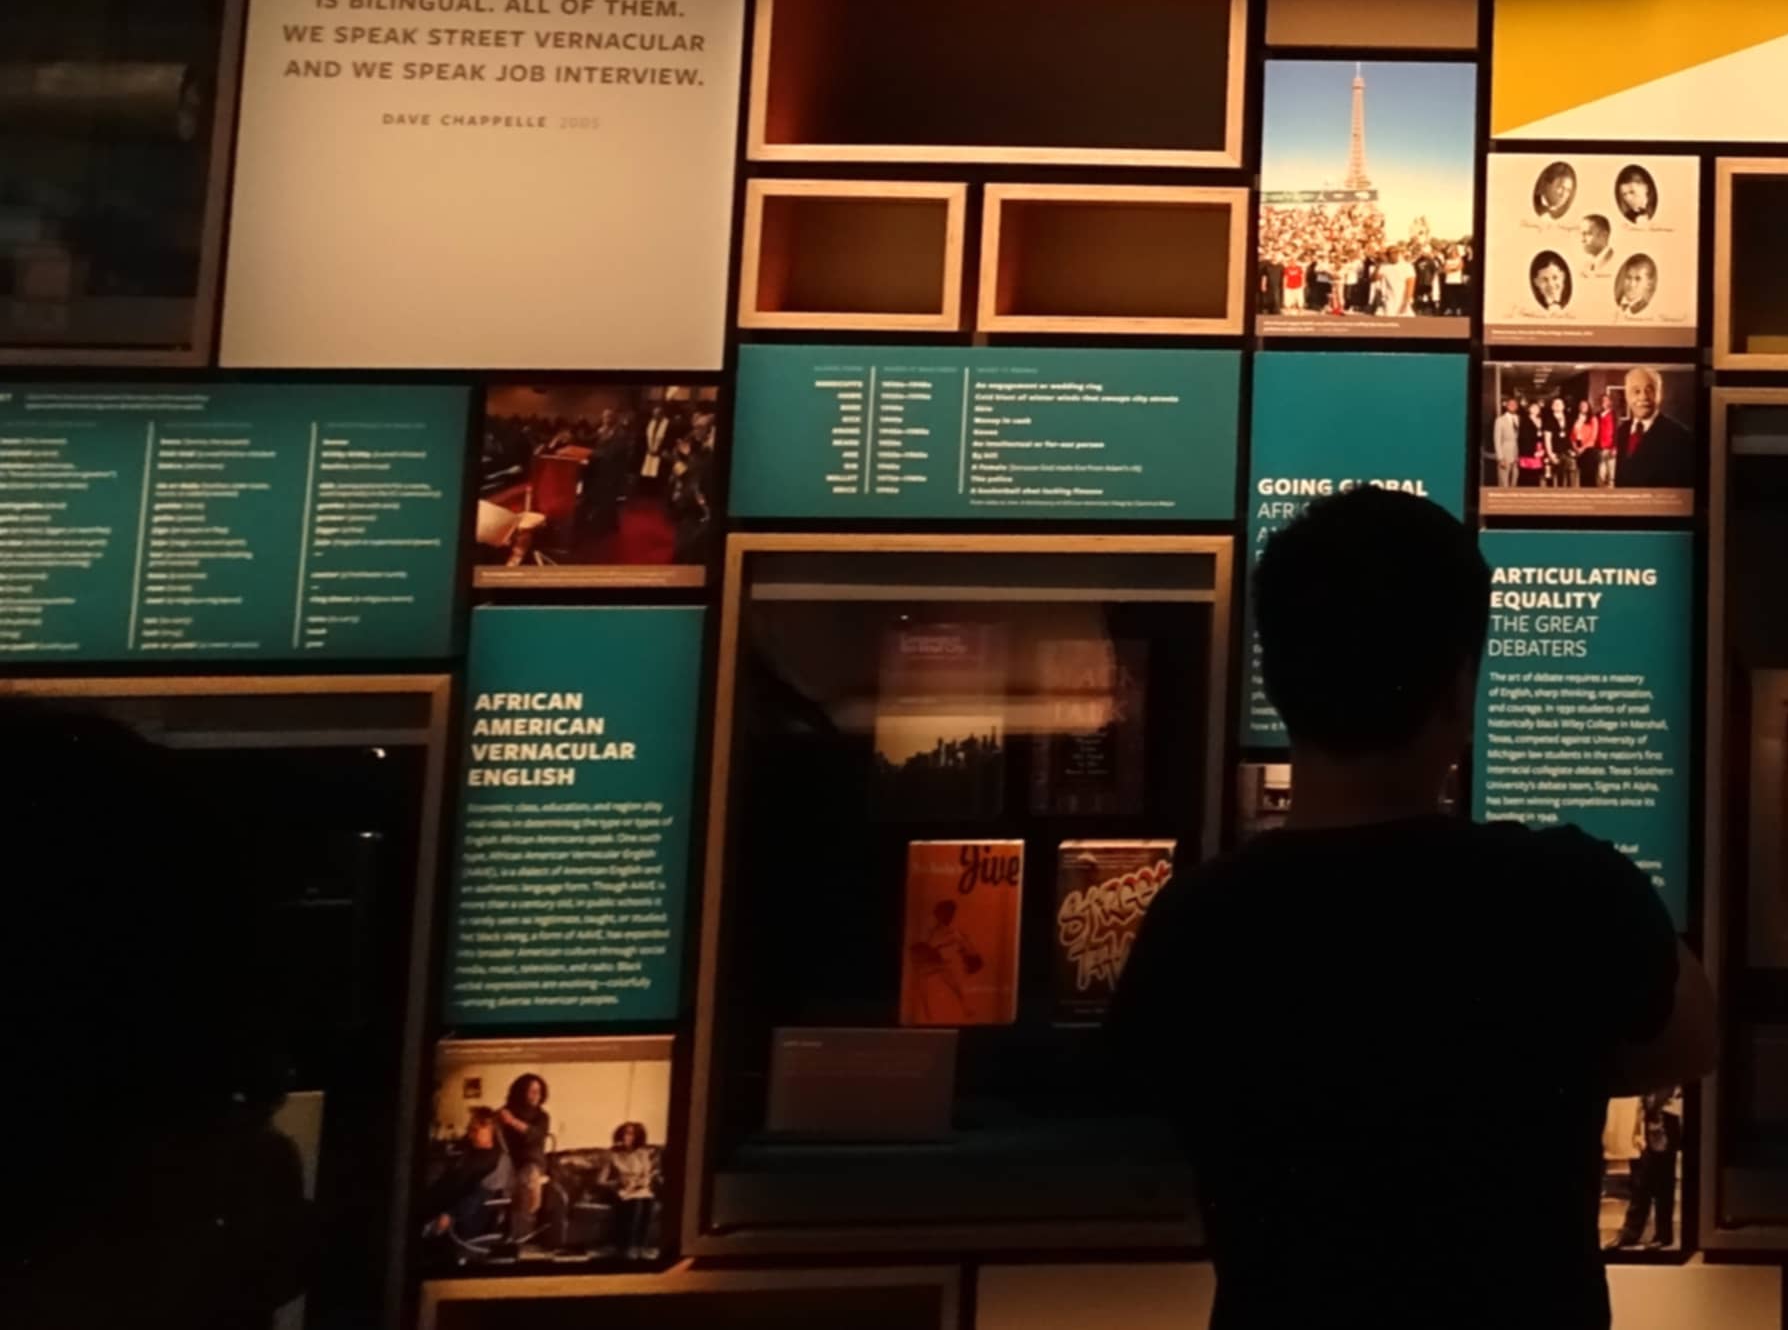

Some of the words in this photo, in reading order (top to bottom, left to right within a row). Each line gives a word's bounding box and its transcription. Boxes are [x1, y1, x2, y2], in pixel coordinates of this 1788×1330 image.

[282, 24, 323, 42] WE
[334, 26, 417, 43] SPEAK
[428, 28, 525, 46] STREET
[534, 31, 704, 50] VERNACULAR
[284, 60, 341, 77] AND
[352, 61, 392, 78] WE
[403, 62, 485, 79] SPEAK
[495, 64, 545, 81] JOB
[555, 66, 703, 84] INTERVIEW.
[382, 113, 429, 125] DAVE
[439, 115, 545, 127] CHAPPELLE
[1258, 478, 1333, 496] GOING
[1339, 479, 1429, 497] GBAL
[1491, 568, 1656, 584] ARTICULATING
[1490, 591, 1601, 609] EQUALITY
[1491, 615, 1529, 632] THE
[1535, 615, 1598, 632] GREAT
[1488, 639, 1586, 656] DEBATERS
[475, 693, 582, 709] AFRICAN
[473, 718, 603, 734] AMERICAN
[472, 743, 634, 759] VERNACULAR
[469, 768, 574, 785] ENGLISH
